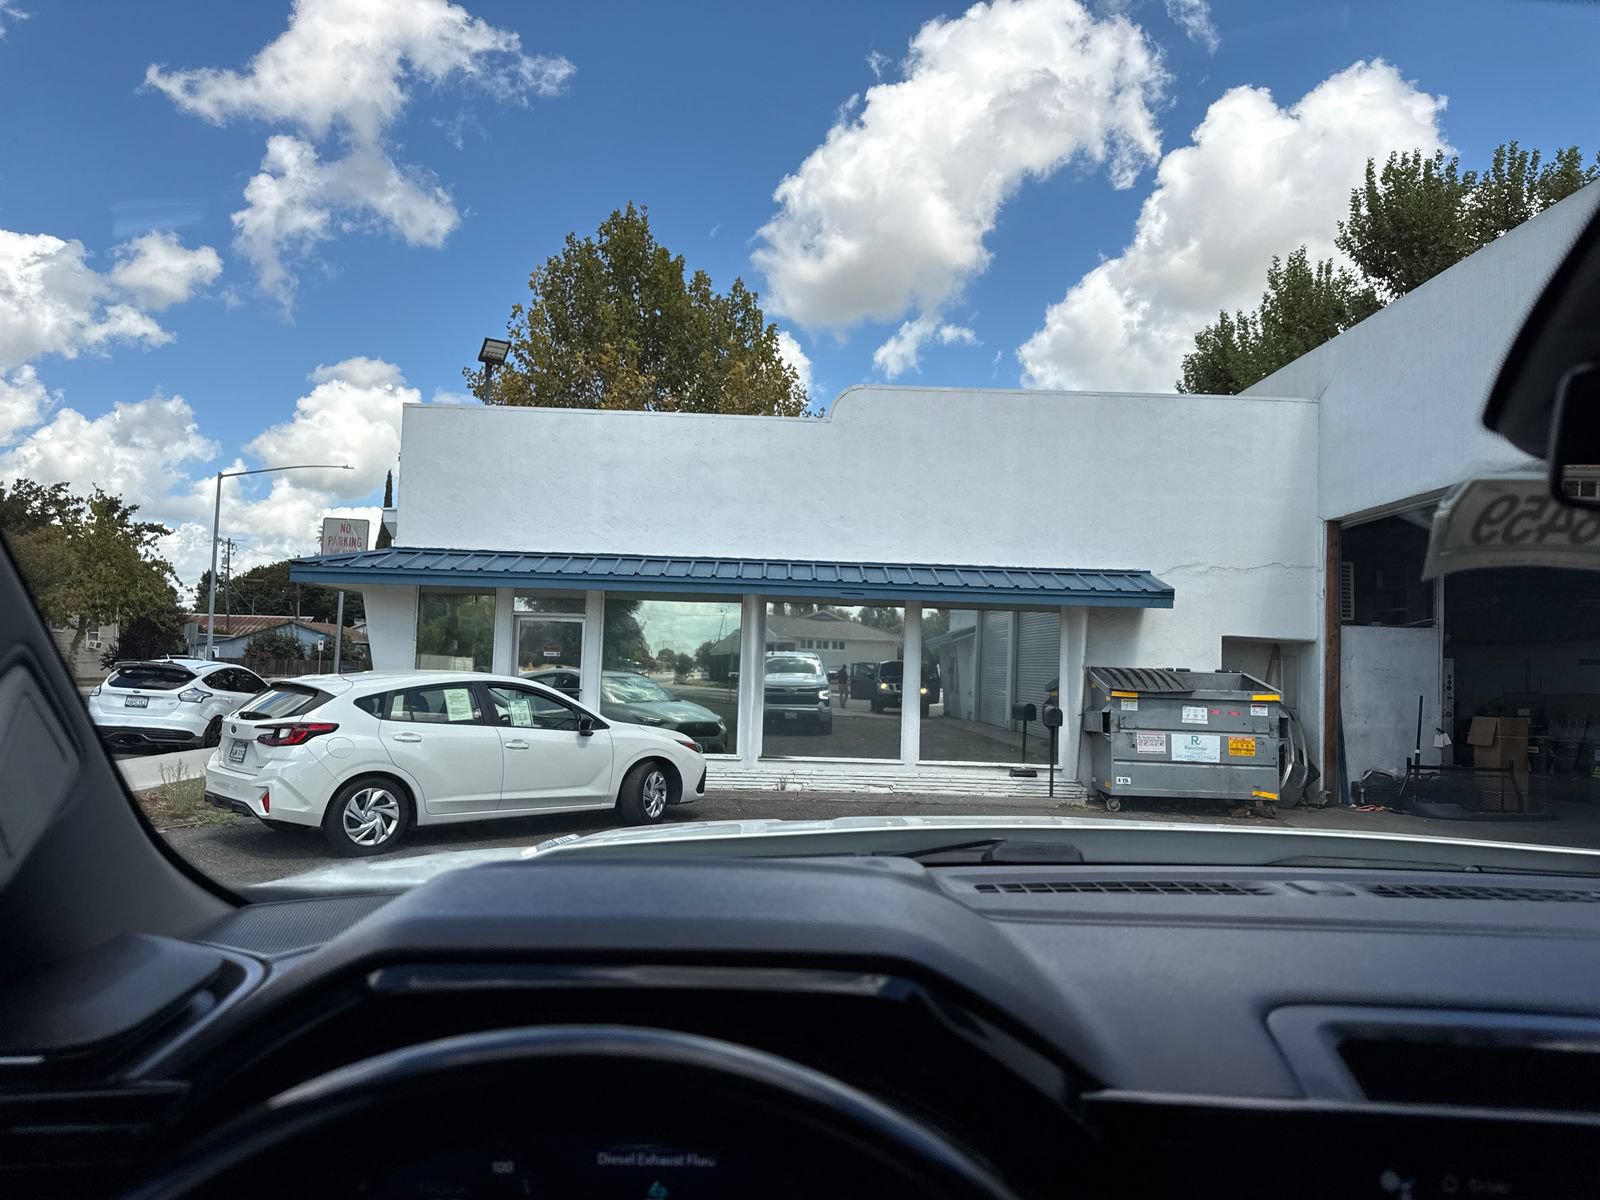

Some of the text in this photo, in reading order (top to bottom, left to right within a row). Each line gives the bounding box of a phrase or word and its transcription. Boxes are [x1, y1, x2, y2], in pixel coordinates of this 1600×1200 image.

[340, 522, 352, 534] NO
[328, 535, 362, 548] PARKING
[597, 1151, 635, 1166] Diesel
[638, 1151, 684, 1166] Exhaust
[491, 1160, 515, 1174] 100
